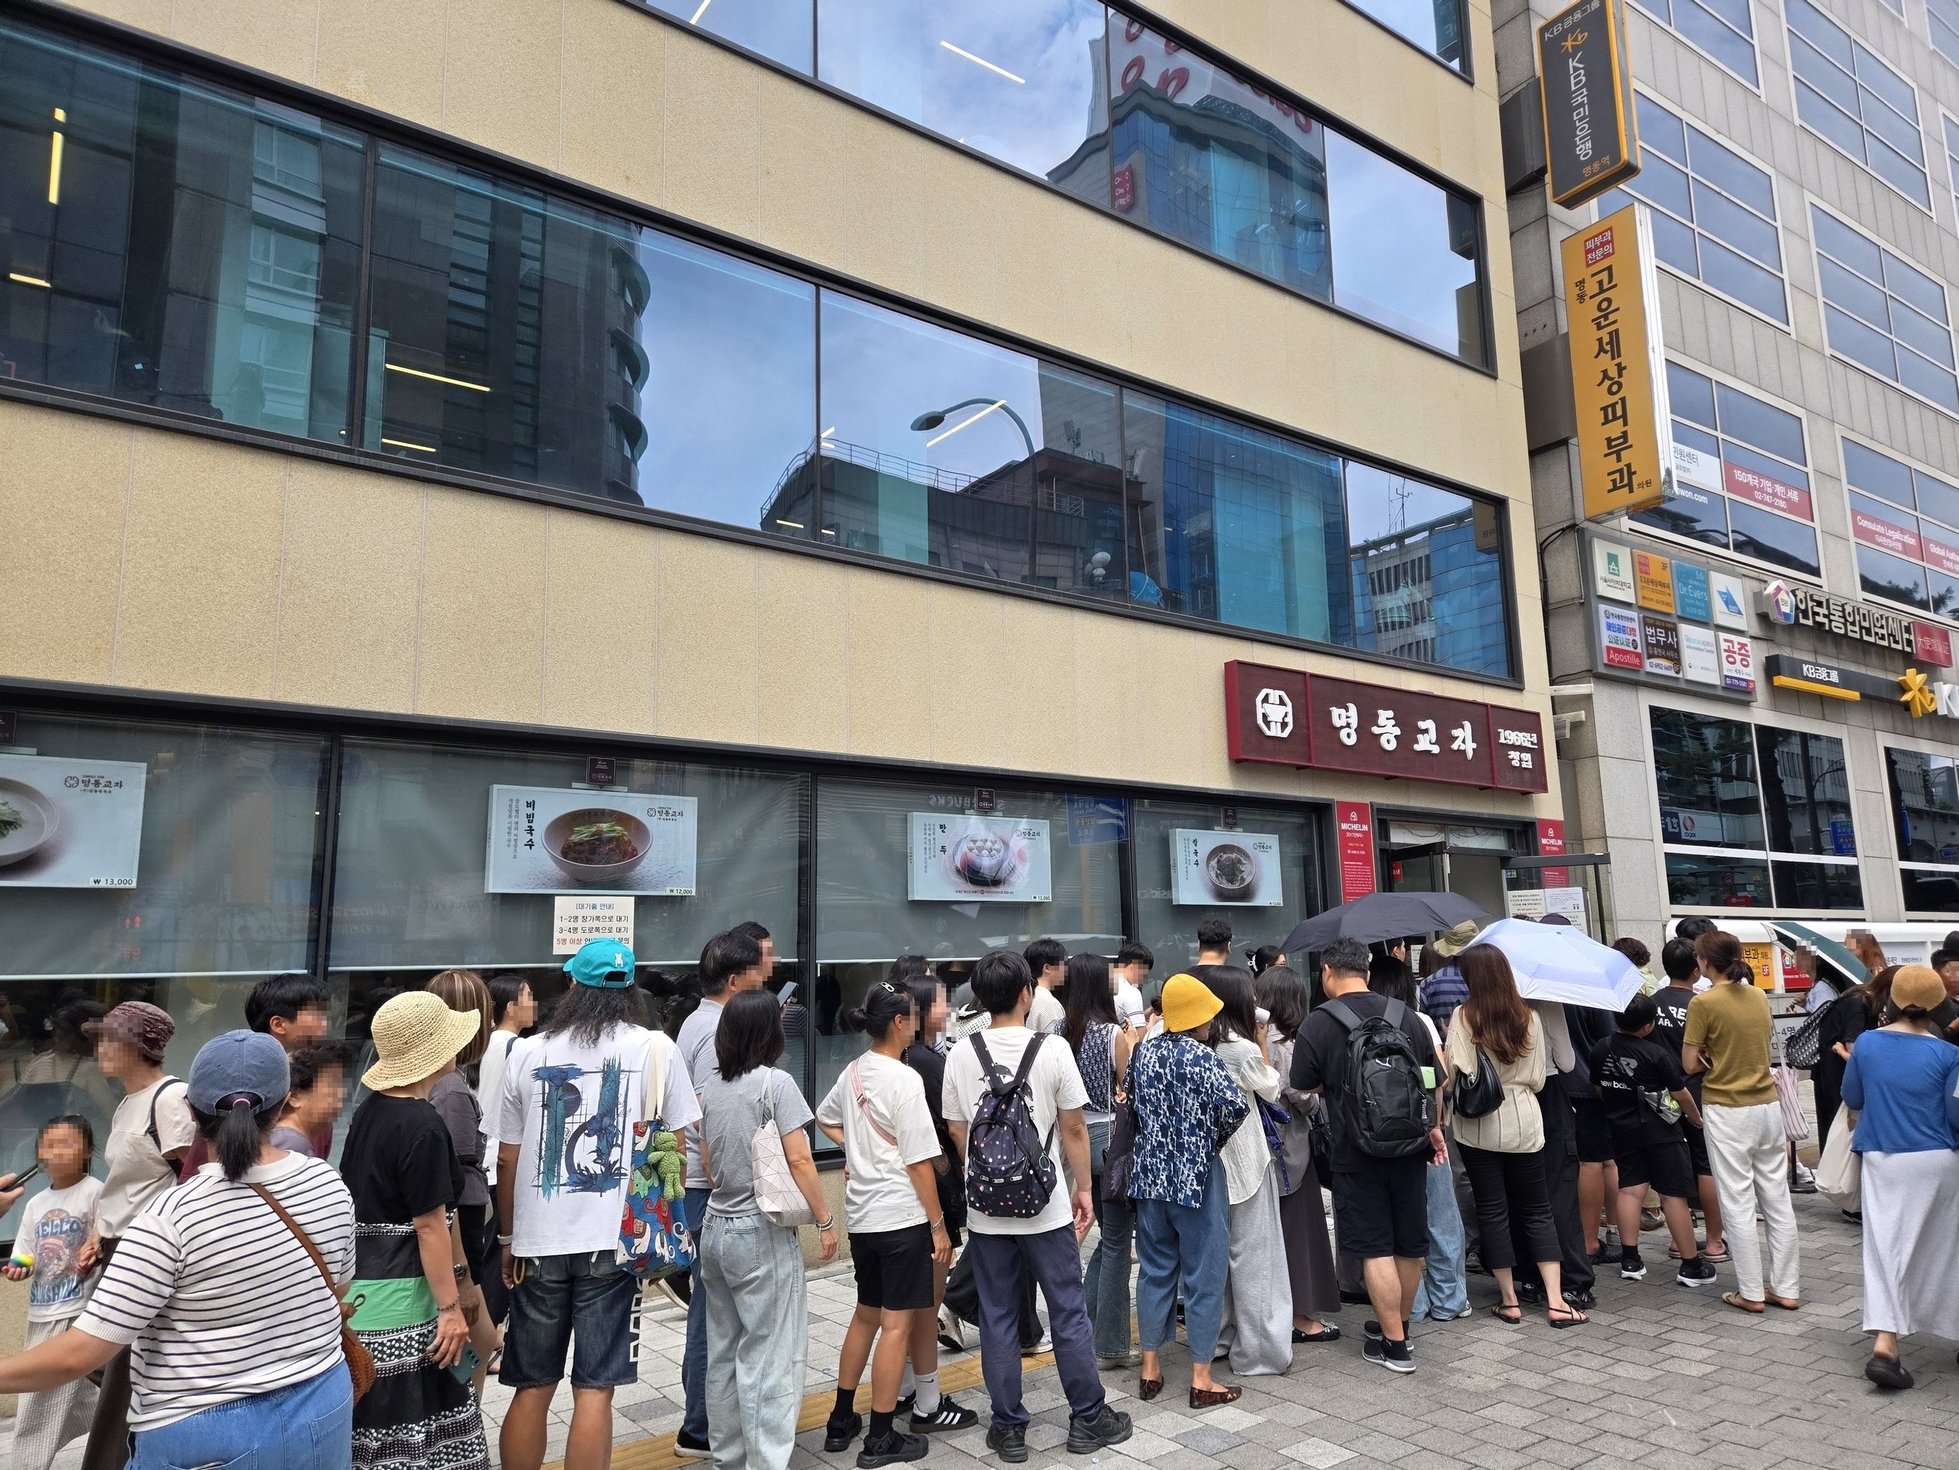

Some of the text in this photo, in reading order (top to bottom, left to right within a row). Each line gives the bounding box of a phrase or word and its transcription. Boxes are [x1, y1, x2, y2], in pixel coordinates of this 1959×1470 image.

[1568, 50, 1593, 161] KB국민은행
[1582, 155, 1611, 177] 명동역
[1585, 230, 1612, 250] 피부과
[1586, 243, 1614, 265] 전문의
[1574, 278, 1588, 305] 명동
[1589, 264, 1638, 494] 고운세상피부과
[1636, 479, 1653, 490] 의원
[1733, 469, 1760, 488] 150개국
[1796, 588, 1917, 654] 한국통합민원센터
[1645, 625, 1678, 649] 법무사
[1609, 649, 1640, 666] Apostille
[1723, 638, 1751, 668] 공증
[1802, 663, 1840, 684] KB금융그룹
[1329, 702, 1477, 761] 명동교자
[1497, 728, 1539, 749] 1966년
[81, 778, 124, 790] 명동교자
[523, 799, 536, 851] 비빔국수
[1341, 822, 1368, 832] MICHELIN
[1541, 838, 1563, 846] MICHELIN
[104, 878, 133, 887] 13,000
[615, 915, 629, 923] 대기
[580, 926, 614, 934] 도로쪽으로
[615, 926, 629, 934] 대기
[556, 937, 567, 946] 5명
[569, 937, 582, 945] 이상
